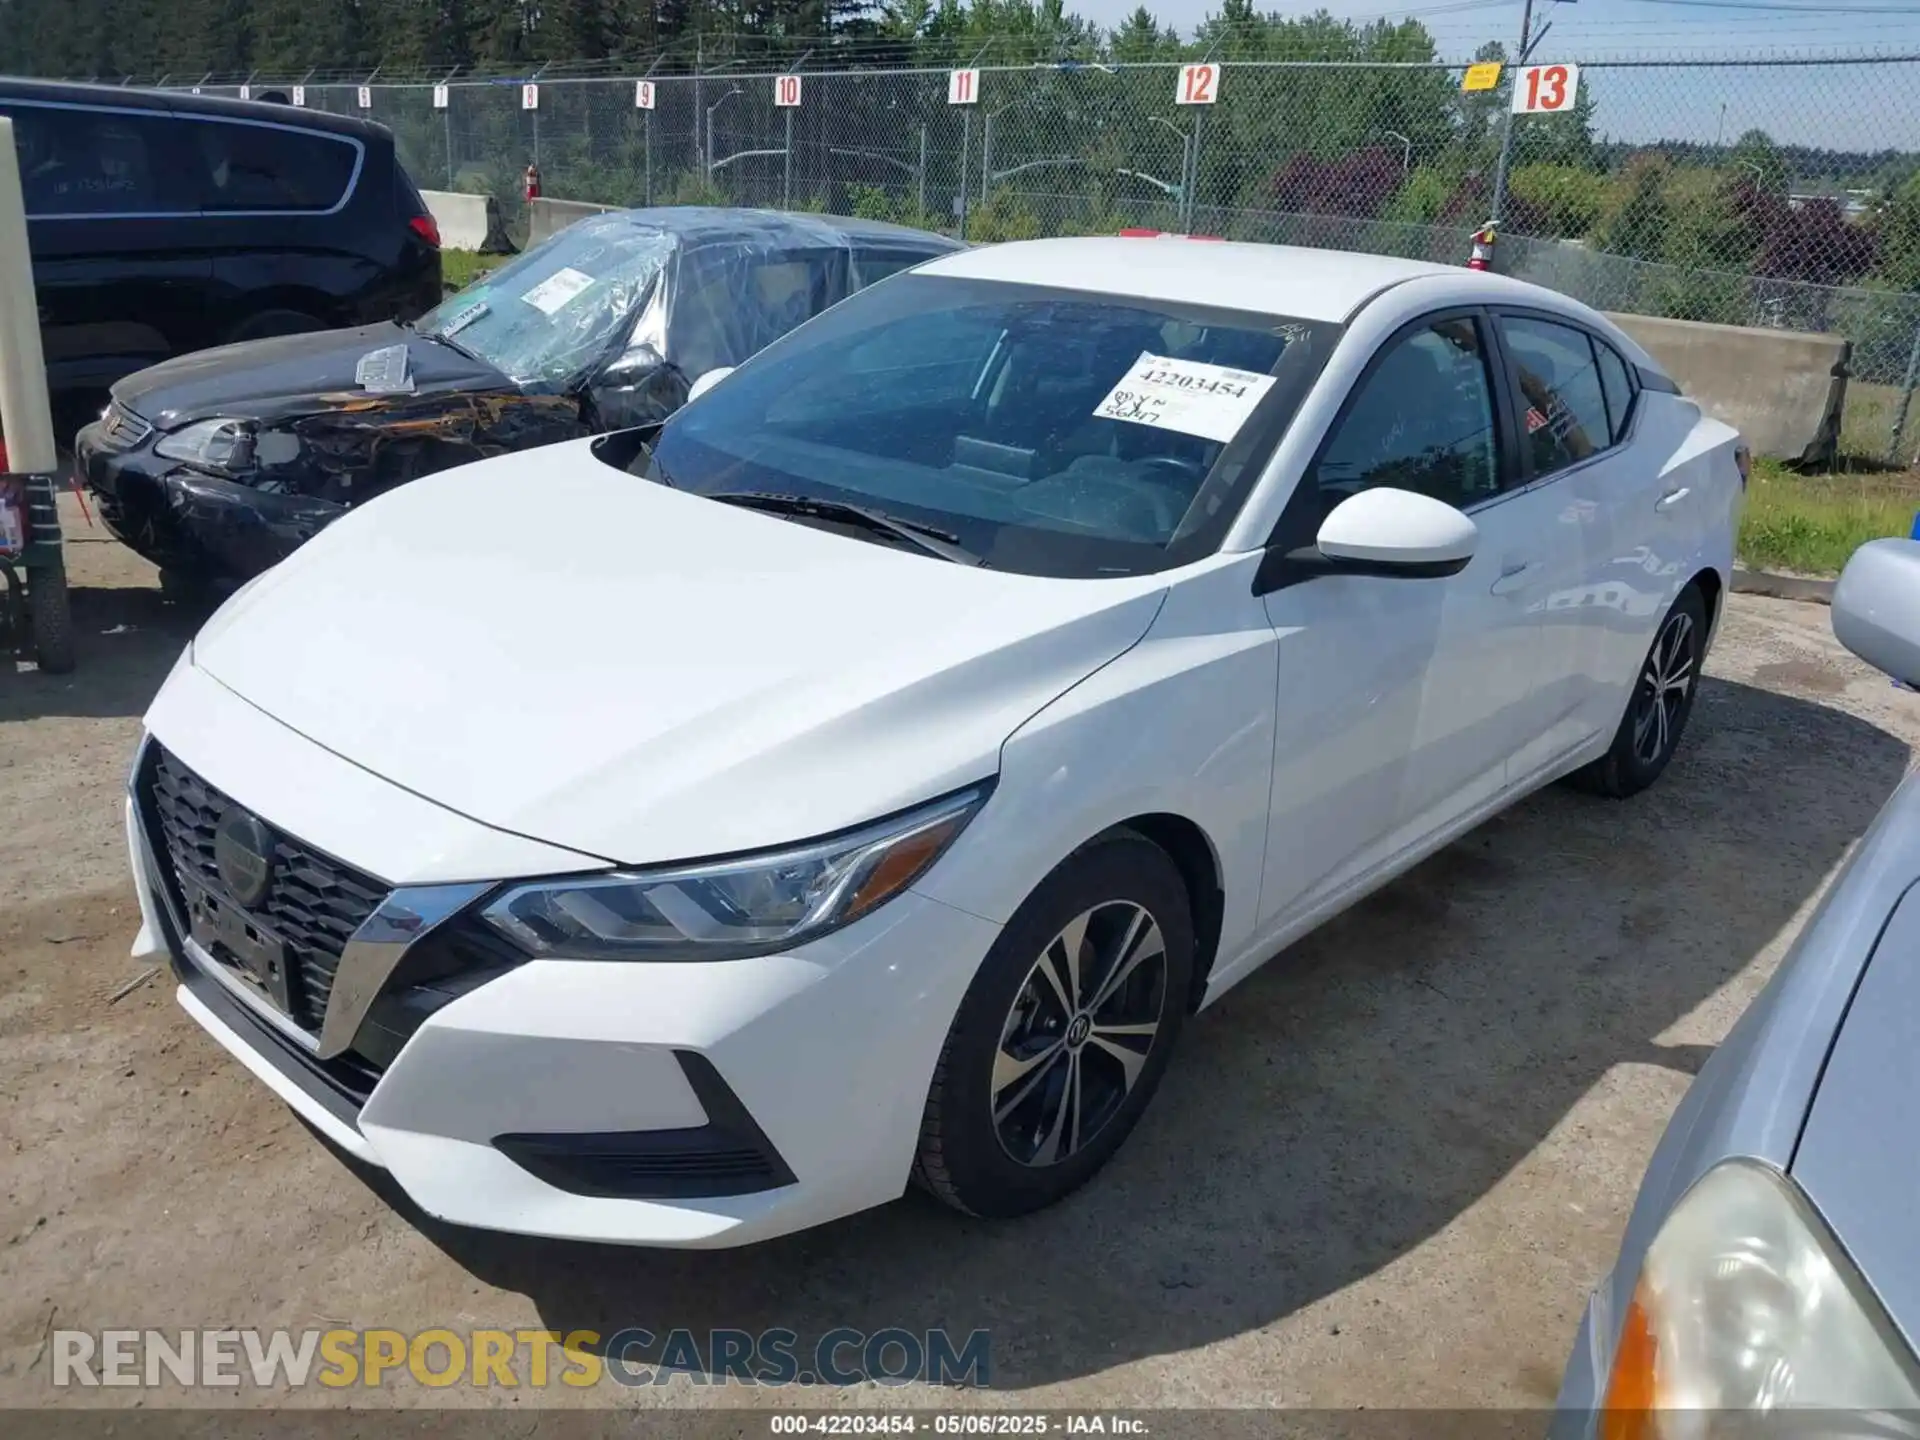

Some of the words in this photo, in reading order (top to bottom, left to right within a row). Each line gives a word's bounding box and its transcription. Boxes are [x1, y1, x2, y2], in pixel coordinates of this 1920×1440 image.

[641, 83, 649, 106] 9
[779, 78, 797, 104] 10
[956, 72, 972, 101] 11
[1185, 66, 1212, 101] 12
[1526, 66, 1568, 110] 13
[1140, 369, 1248, 399] 42203454
